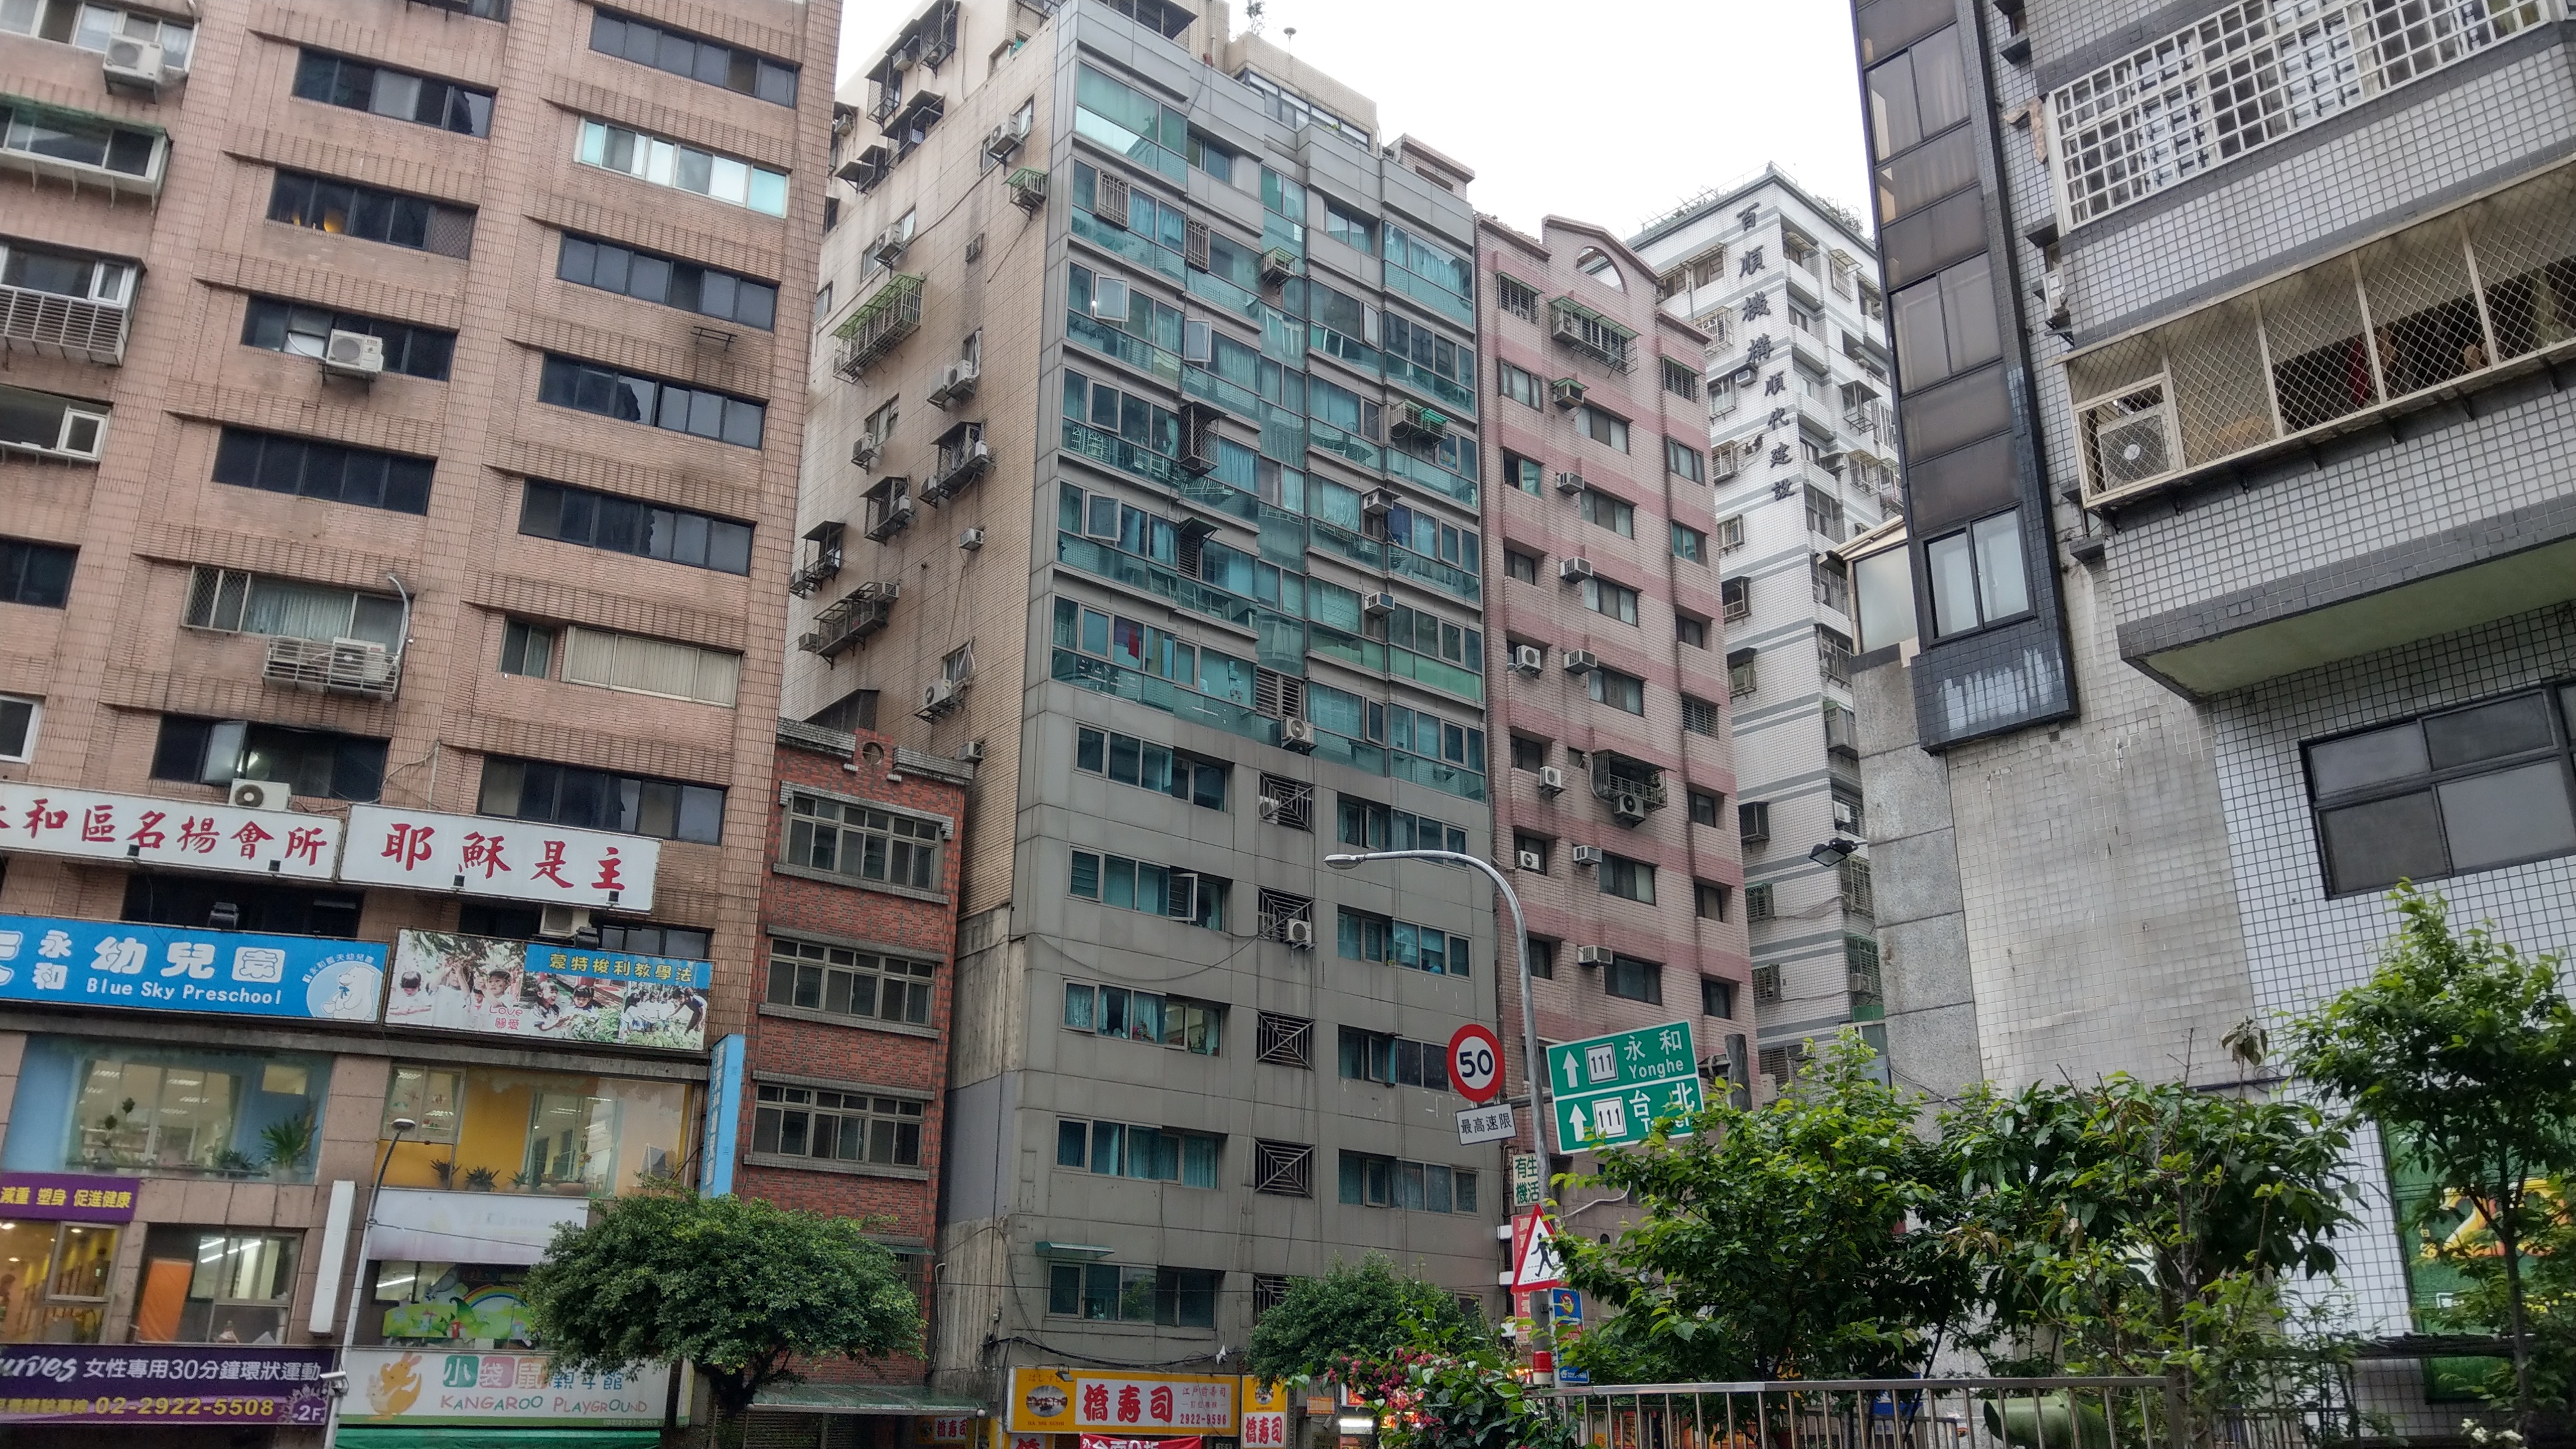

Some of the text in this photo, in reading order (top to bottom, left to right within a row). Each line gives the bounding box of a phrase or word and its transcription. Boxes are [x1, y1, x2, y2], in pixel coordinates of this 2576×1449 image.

[0, 798, 327, 866] 和區名揚會所
[381, 823, 625, 890] 耶穌是主
[549, 953, 693, 983] 蒙特梭利教學法
[86, 977, 281, 1005] Blue Sky Preschool
[1624, 1028, 1683, 1061] 永和
[1459, 1049, 1493, 1078] 50
[1591, 1054, 1613, 1074] 111
[1628, 1058, 1684, 1079] Yonghe
[1629, 1082, 1695, 1118] 台北
[1461, 1113, 1512, 1133] 最高速限
[1598, 1108, 1623, 1130] 111
[0, 1354, 78, 1383] urves
[95, 1396, 274, 1416] 02-2922-5508
[298, 1405, 321, 1421] 2F
[1180, 1413, 1227, 1425] 2922-9596
